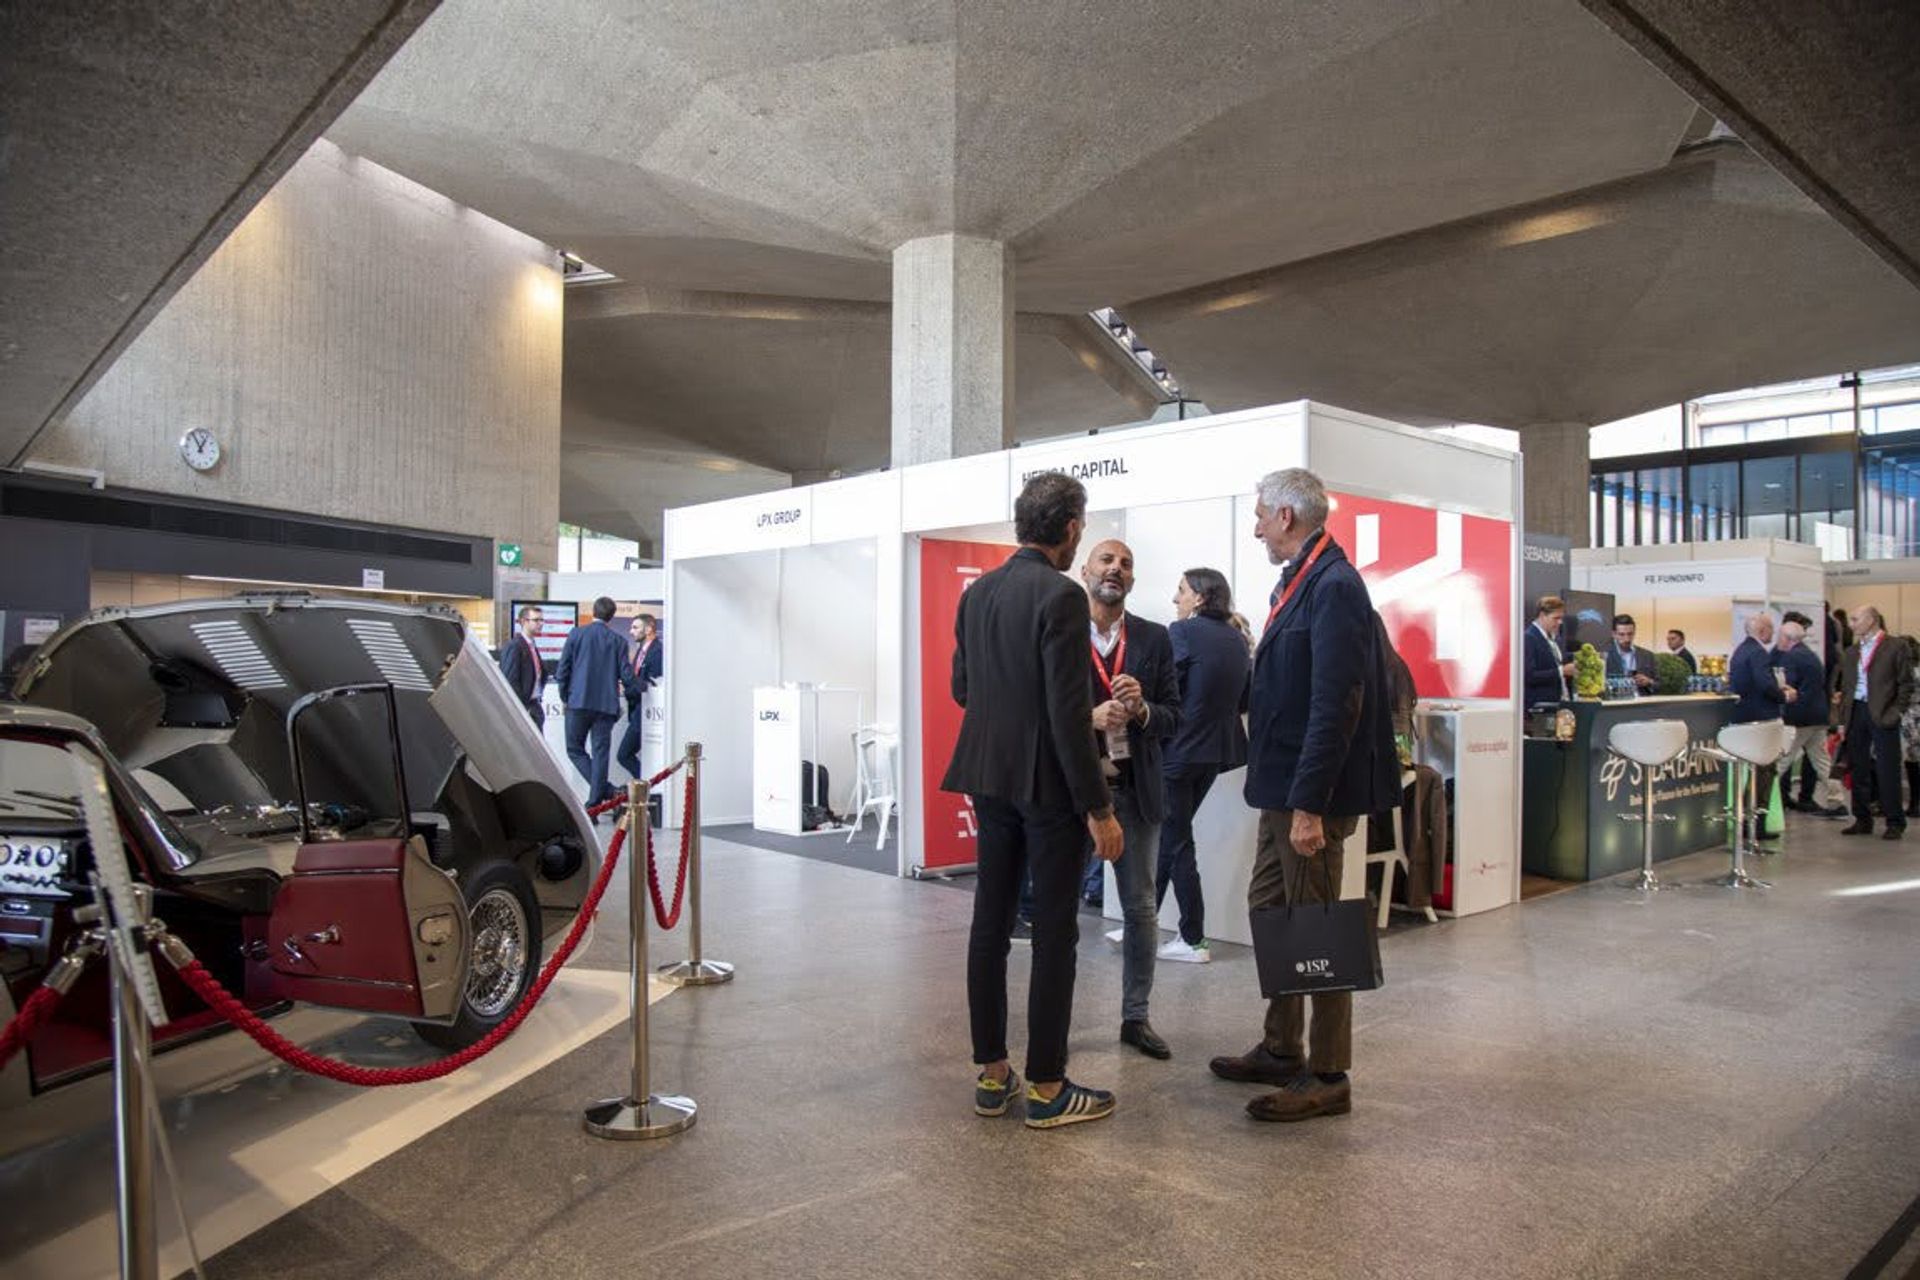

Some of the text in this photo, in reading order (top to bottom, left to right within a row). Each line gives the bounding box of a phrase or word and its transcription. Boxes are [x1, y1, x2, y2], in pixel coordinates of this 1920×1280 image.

[1071, 458, 1128, 481] CAPITAL
[756, 508, 801, 528] LPX GROUP
[546, 704, 565, 716] IS
[759, 710, 779, 721] LPX
[1306, 960, 1329, 972] ISP
